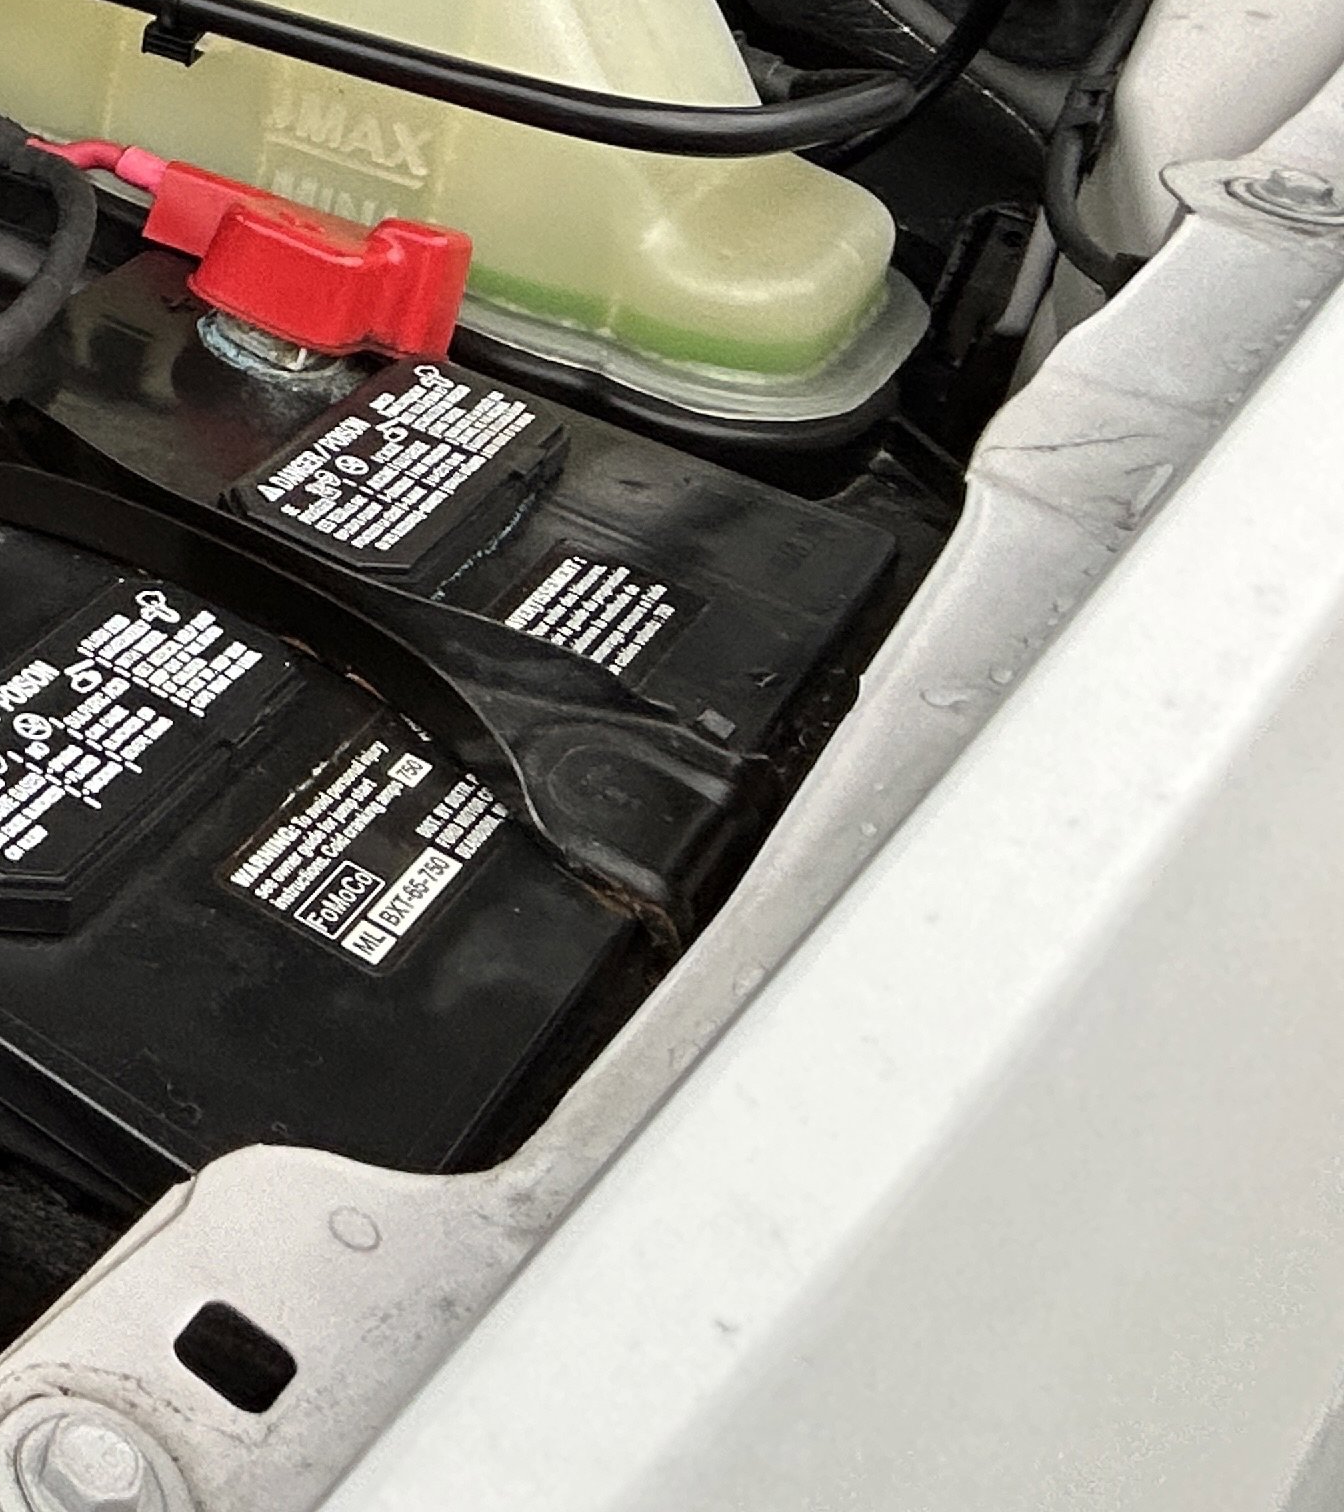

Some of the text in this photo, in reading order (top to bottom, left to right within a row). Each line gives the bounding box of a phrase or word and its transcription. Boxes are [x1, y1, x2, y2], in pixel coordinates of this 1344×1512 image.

[295, 93, 434, 176] MAX
[230, 825, 302, 888] WARNING:
[305, 791, 334, 820] avoid
[326, 758, 367, 800] personal
[358, 740, 390, 765] injury
[255, 880, 273, 900] see
[271, 851, 303, 883] owner
[298, 829, 327, 859] guide
[351, 776, 378, 802] start
[321, 832, 351, 858] Cold
[343, 801, 387, 839] cranking
[396, 758, 425, 781] 750
[308, 869, 374, 933] FoMoCo
[352, 856, 451, 955] ML BXT-65-750
